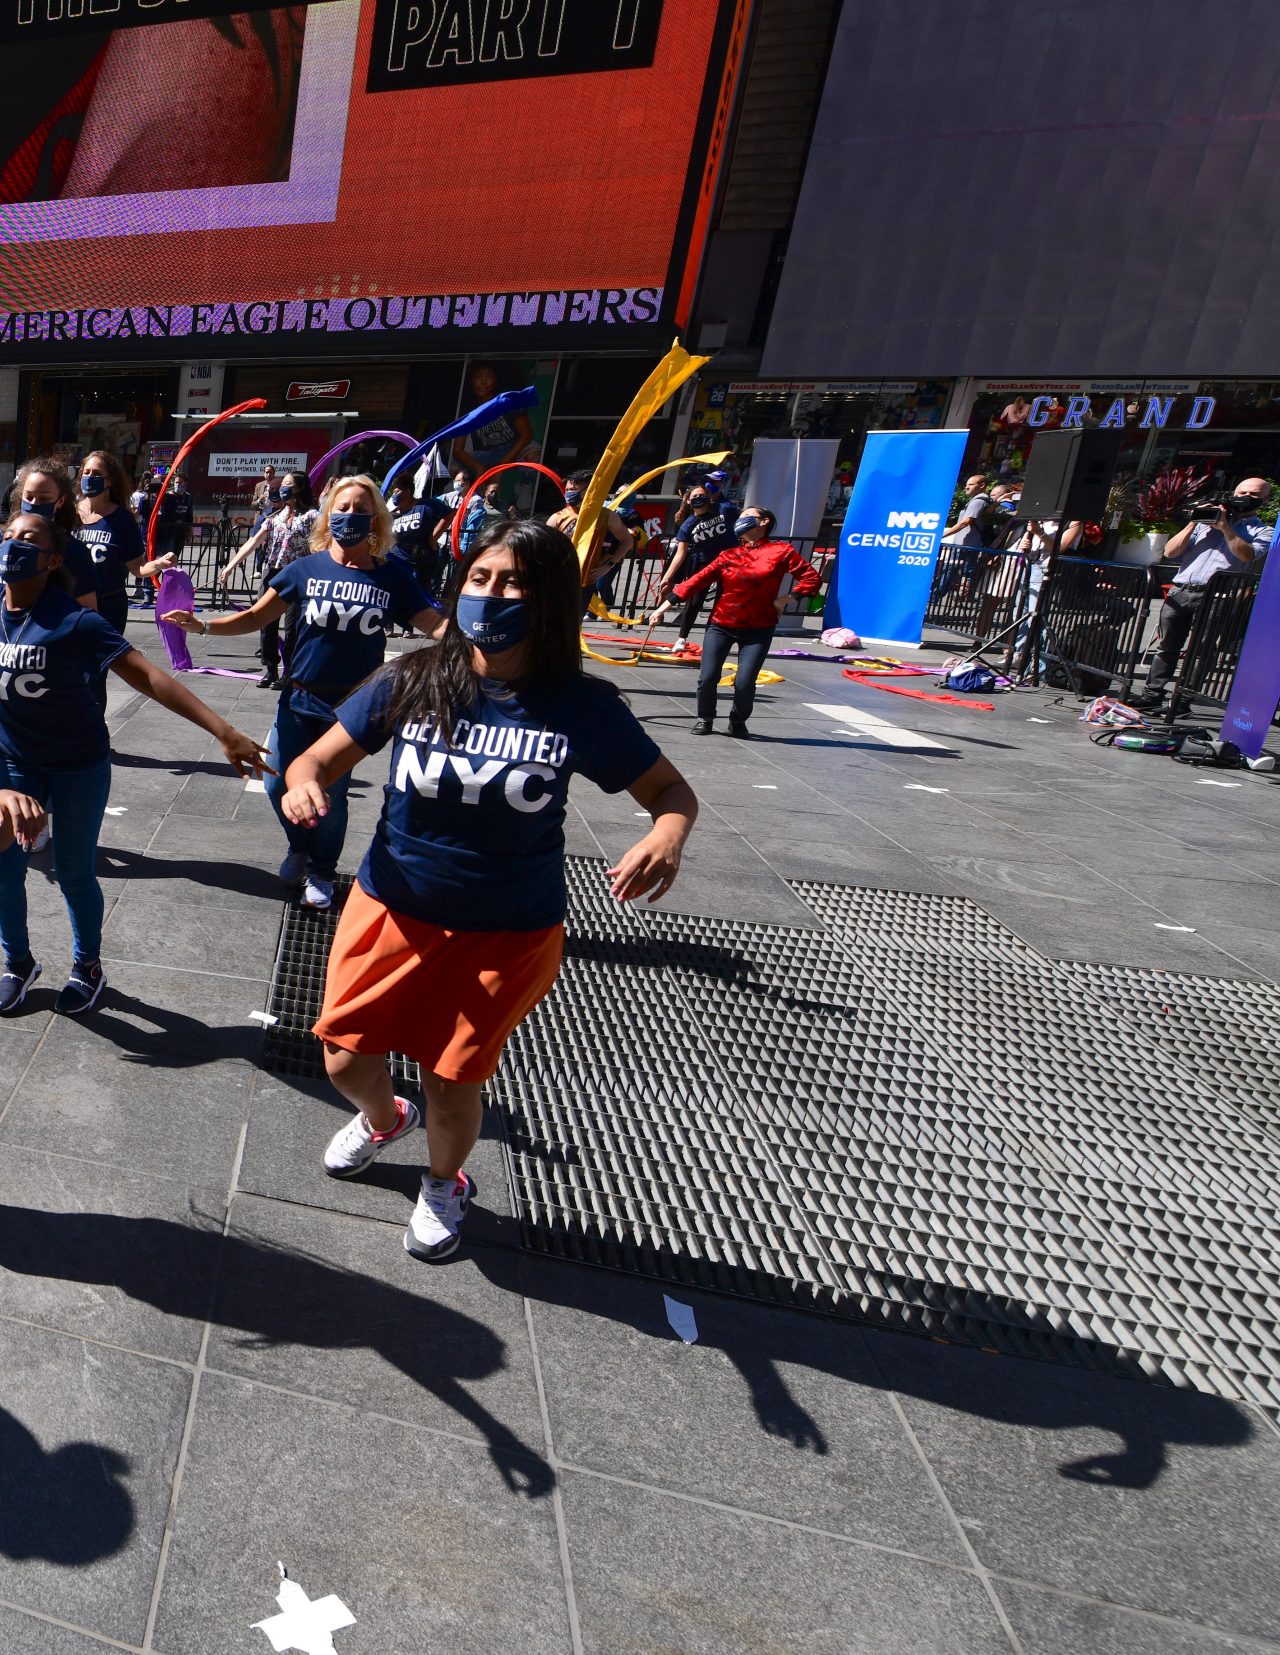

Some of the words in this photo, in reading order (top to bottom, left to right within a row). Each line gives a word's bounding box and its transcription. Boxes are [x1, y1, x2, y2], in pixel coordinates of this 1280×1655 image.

[189, 299, 329, 335] EAGLE
[343, 287, 659, 330] OUTFITTERS
[197, 366, 211, 379] NBA
[297, 384, 340, 396] Tailgate
[1028, 396, 1217, 429] GRAND
[216, 457, 238, 465] DON'T
[239, 457, 258, 465] PLAY
[260, 457, 279, 465] WITH
[280, 457, 300, 465] FIRE.
[392, 520, 420, 533] NYC
[887, 511, 941, 530] NYC
[693, 523, 727, 543] NYC
[847, 533, 931, 550] CENSUS
[897, 555, 930, 567] 2020
[306, 578, 332, 597] GET
[331, 581, 391, 610] COUNTED
[304, 599, 384, 636] NYC
[472, 621, 492, 632] GET
[452, 718, 569, 769] COUNTED
[395, 744, 557, 813] NYC
